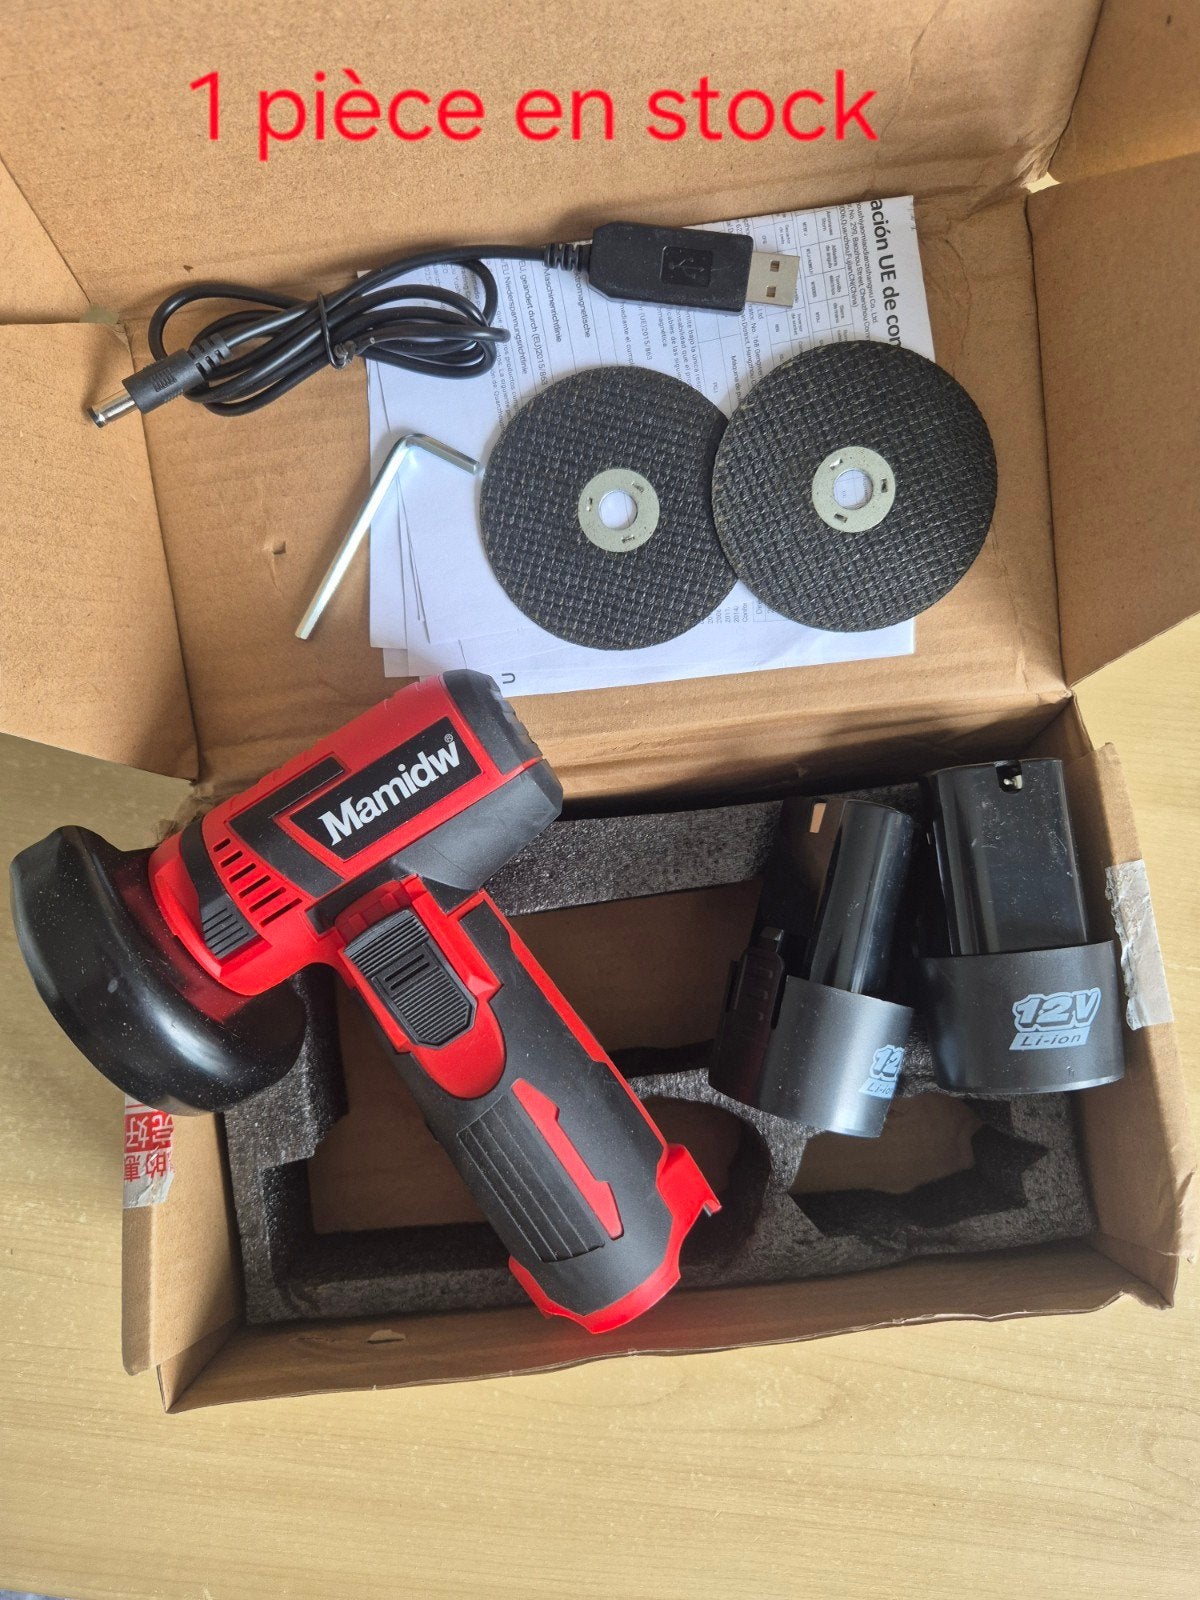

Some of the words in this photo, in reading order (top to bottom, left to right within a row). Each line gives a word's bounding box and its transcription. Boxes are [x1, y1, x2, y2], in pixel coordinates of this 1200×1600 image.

[870, 200, 891, 251] ación
[878, 254, 896, 282] UE
[882, 286, 900, 310] de
[528, 310, 538, 332] durch
[1012, 987, 1101, 1032] 12V
[1021, 1032, 1082, 1047] Li-ion
